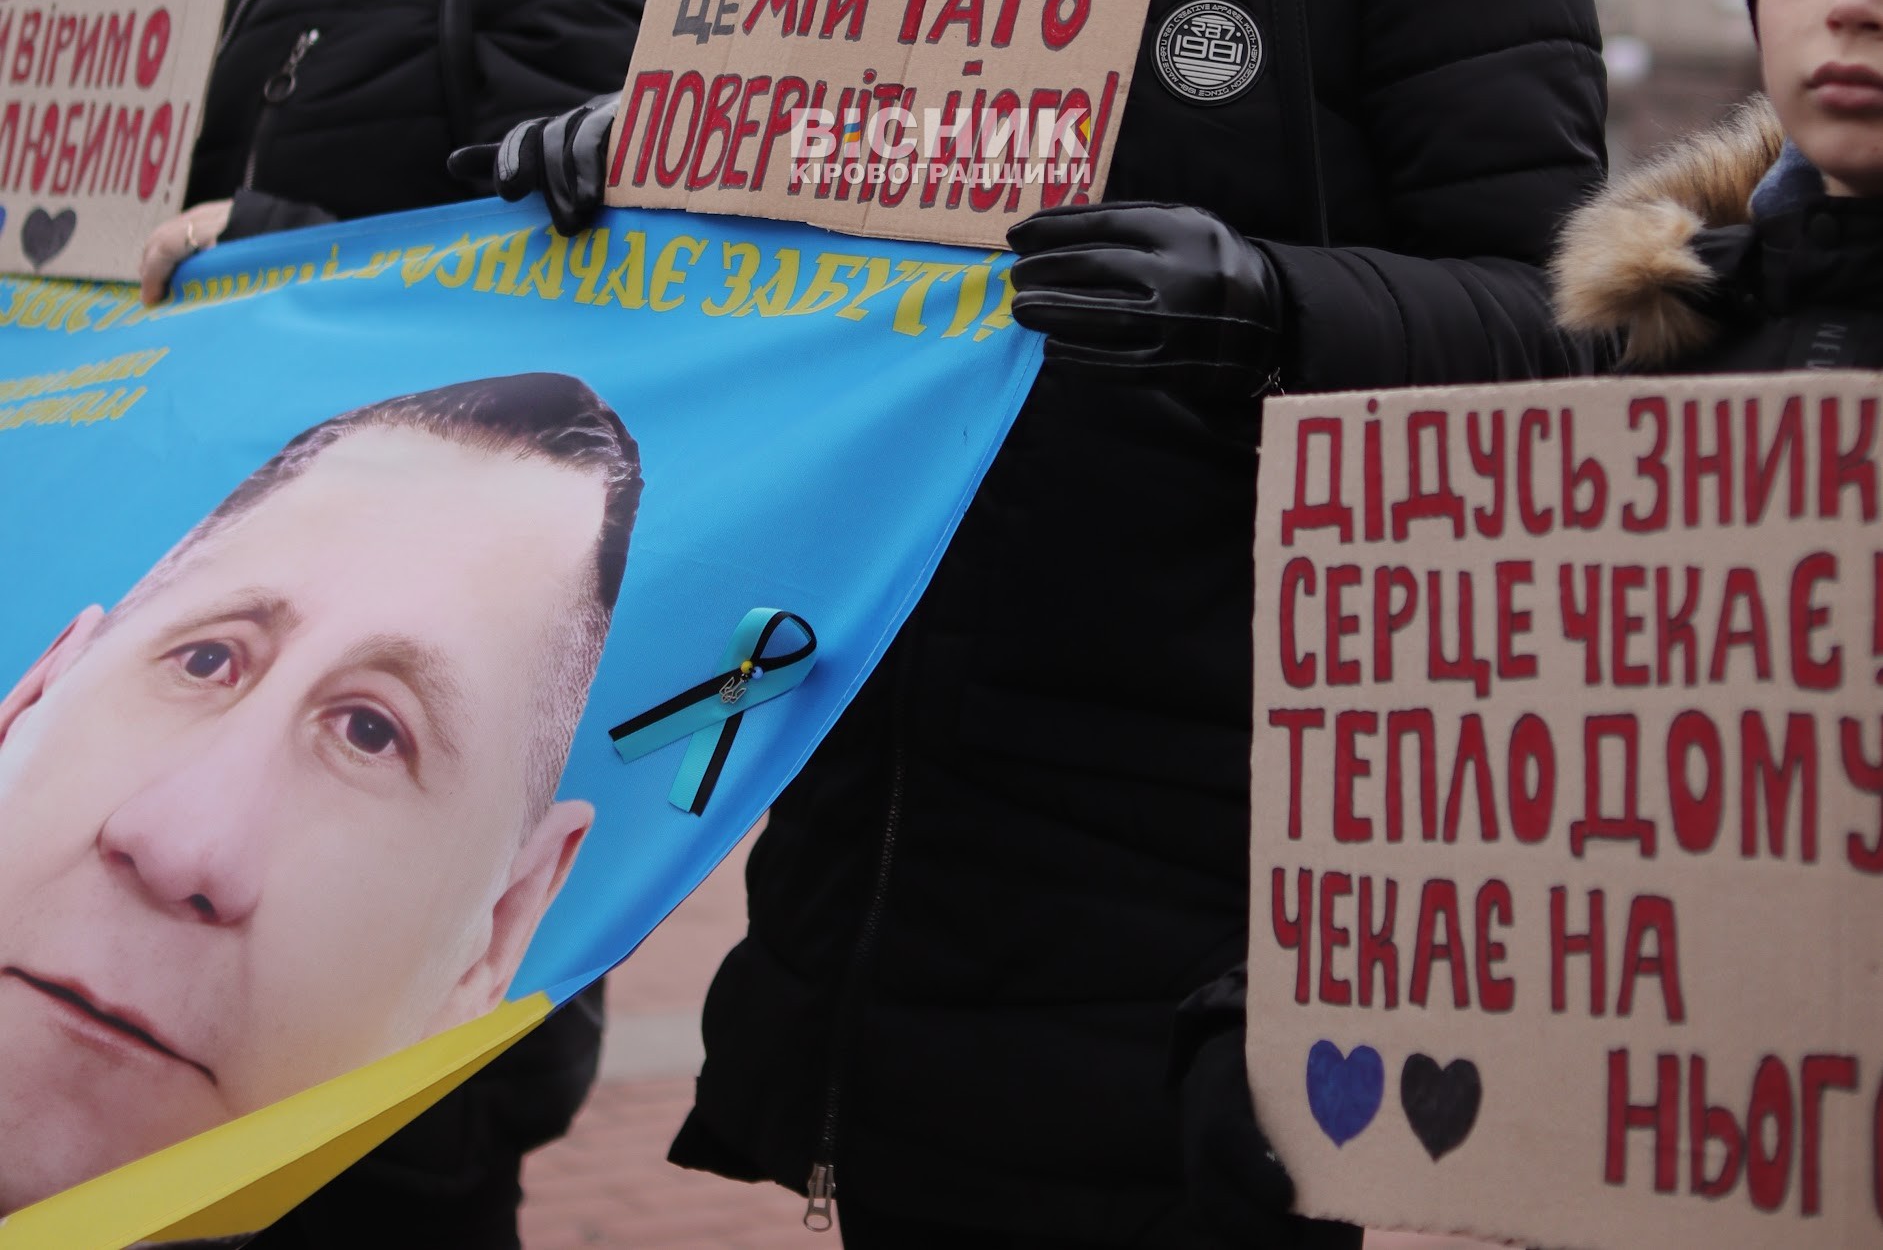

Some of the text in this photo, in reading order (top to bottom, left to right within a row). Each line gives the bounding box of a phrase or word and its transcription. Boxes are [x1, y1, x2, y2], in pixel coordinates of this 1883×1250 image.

[10, 4, 171, 90] ВІРИМО
[1174, 3, 1210, 23] CREATIVE
[1212, 3, 1243, 23] APPAREL
[1174, 34, 1243, 64] 1981
[1281, 395, 1879, 546] ДІДУСЬ ЗНИК
[1279, 556, 1540, 699] СЕРЦЕ
[1269, 707, 1556, 844] ТЕПЛО
[1272, 867, 1686, 1025] ЧЕКАЄ НА
[1604, 1047, 1883, 1218] НЬОГ
